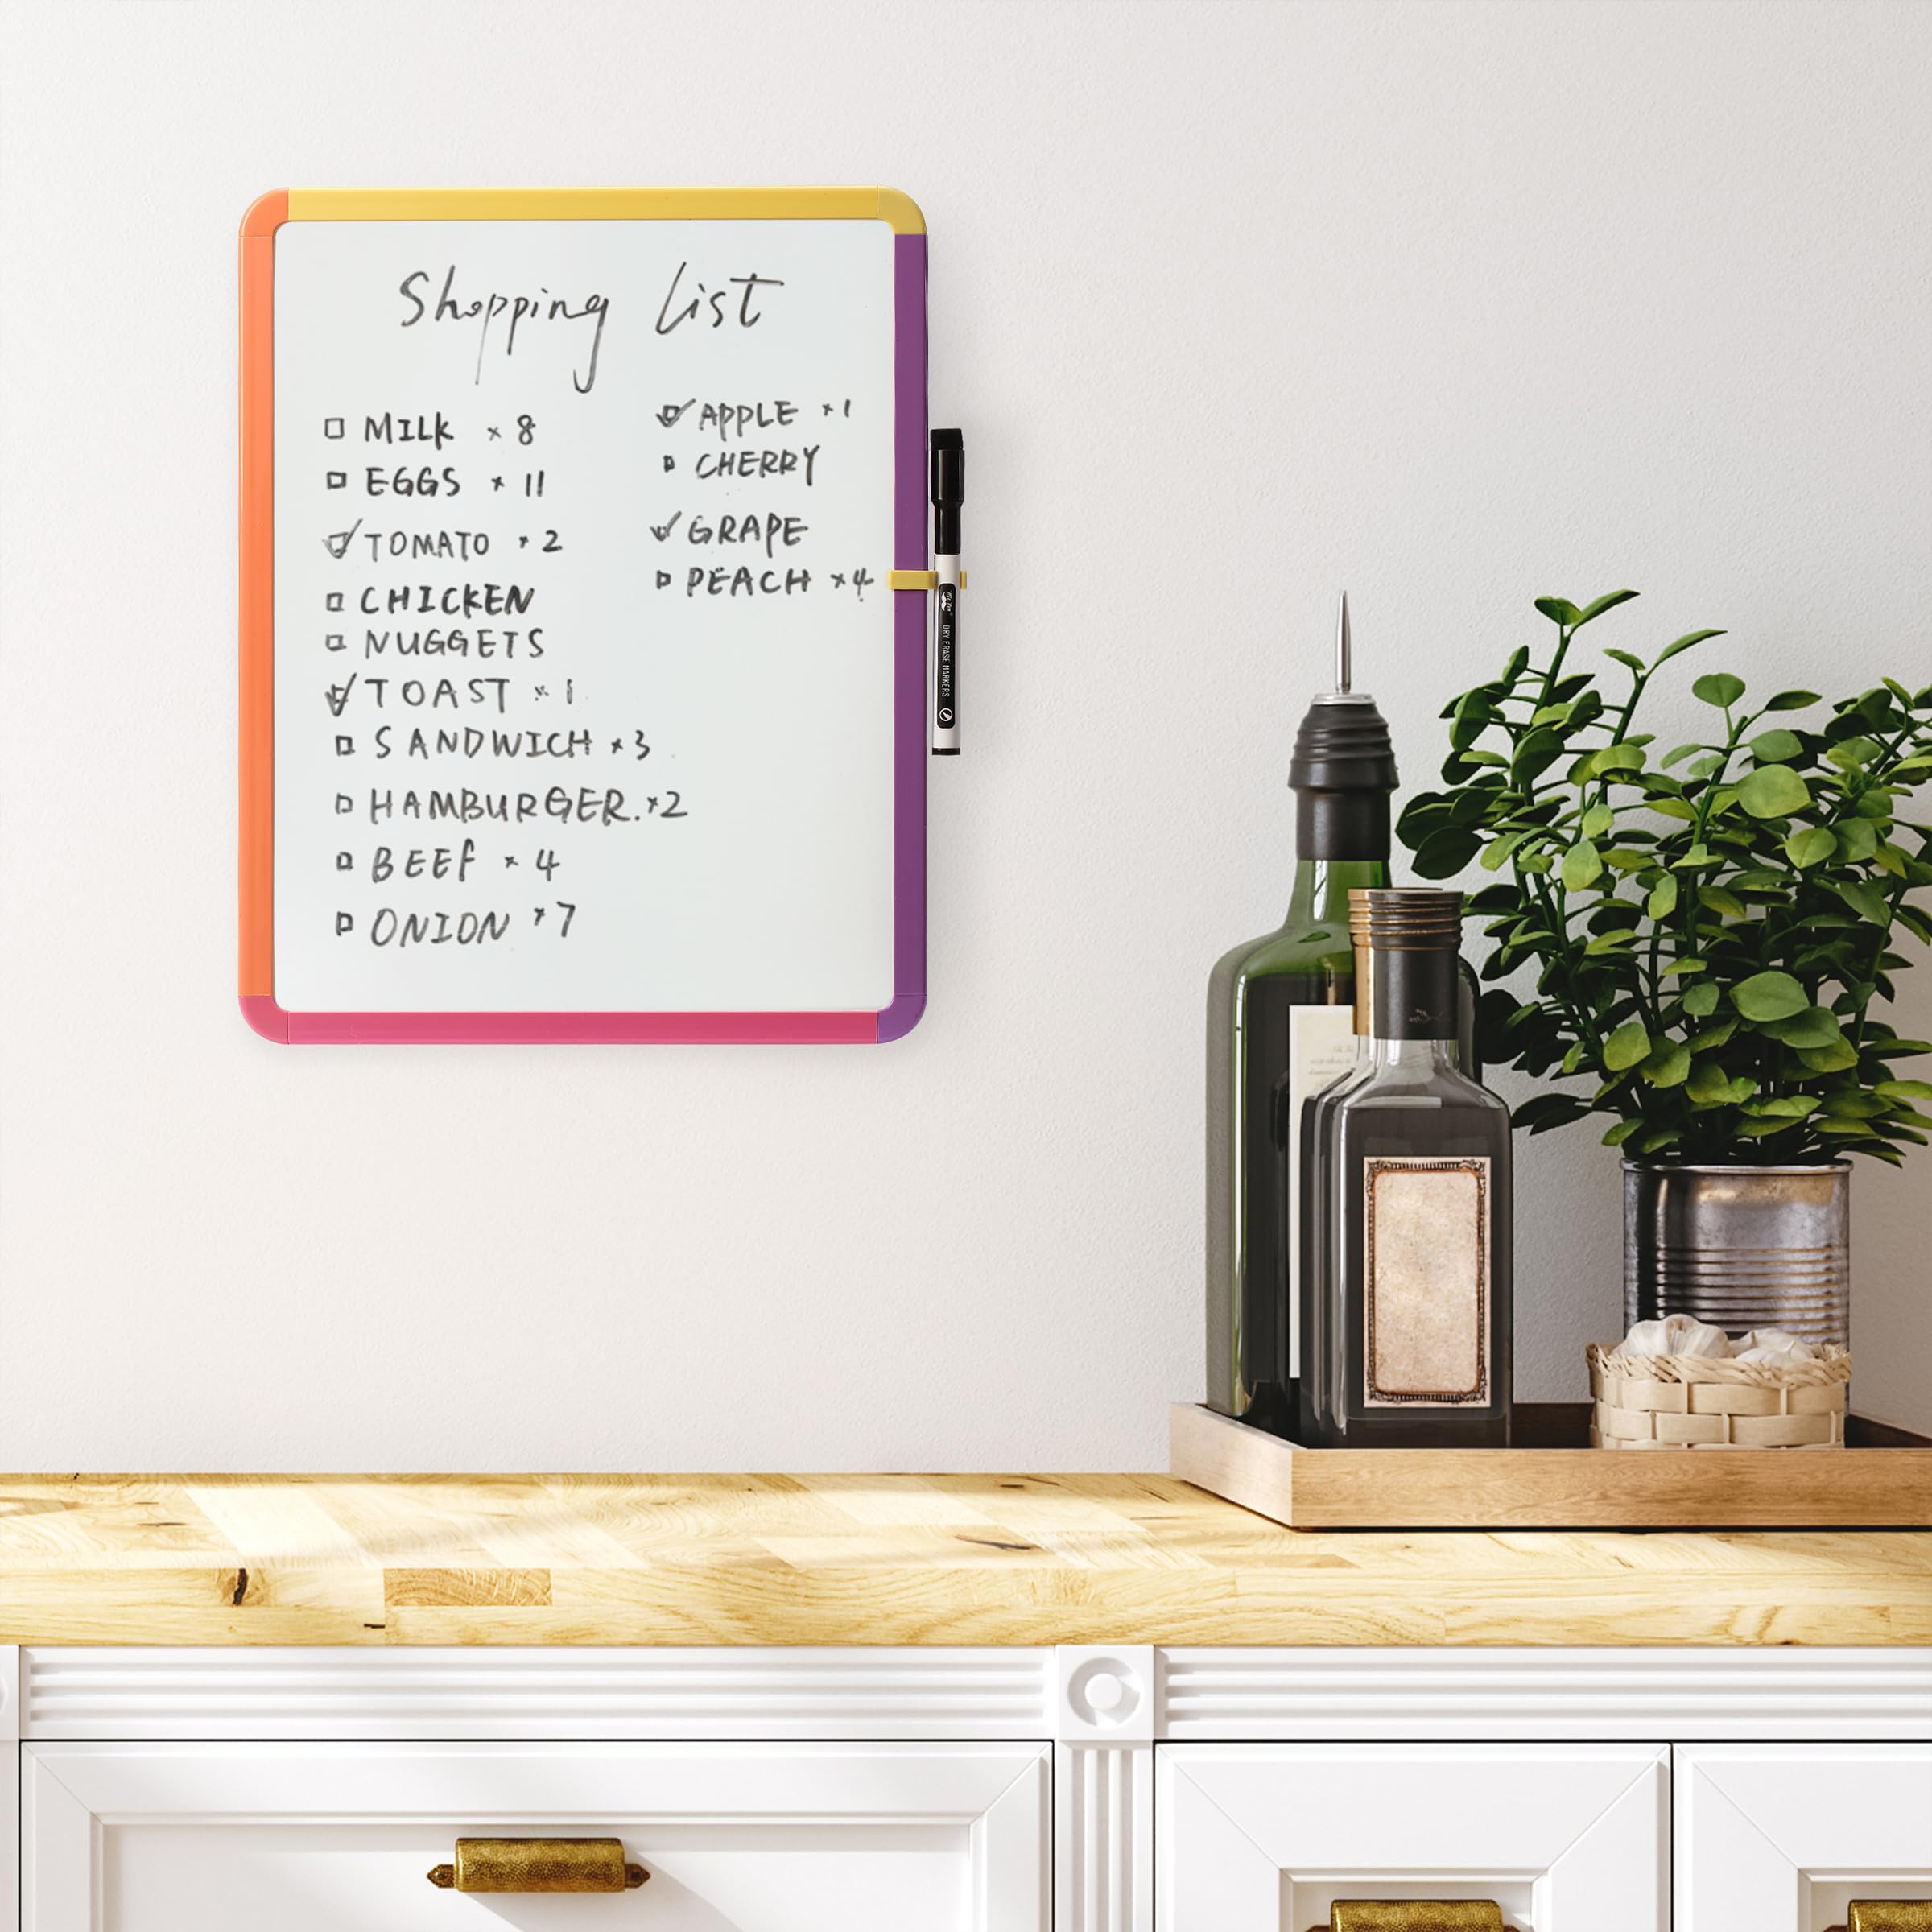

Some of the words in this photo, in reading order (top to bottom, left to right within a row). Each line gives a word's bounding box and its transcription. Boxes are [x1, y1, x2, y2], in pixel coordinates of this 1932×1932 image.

[398, 264, 610, 394] Shopping
[654, 261, 786, 336] List
[364, 411, 455, 451] MILK
[698, 401, 799, 443] APPLE
[365, 465, 461, 498] EGGS
[694, 444, 821, 488] CHERRY
[363, 530, 490, 564] TOMATO
[687, 511, 810, 559] GRAPE
[686, 565, 813, 598] PEACH
[360, 583, 536, 620] CHICKEN
[365, 627, 545, 660] NUGGETS
[941, 625, 951, 638] DRY
[941, 641, 951, 663] ERASE
[364, 677, 511, 715] TOAST
[941, 665, 951, 697] MARKERS
[374, 724, 594, 761] SANDWICH
[371, 837, 476, 885] BEEF
[369, 910, 511, 948] ONION
